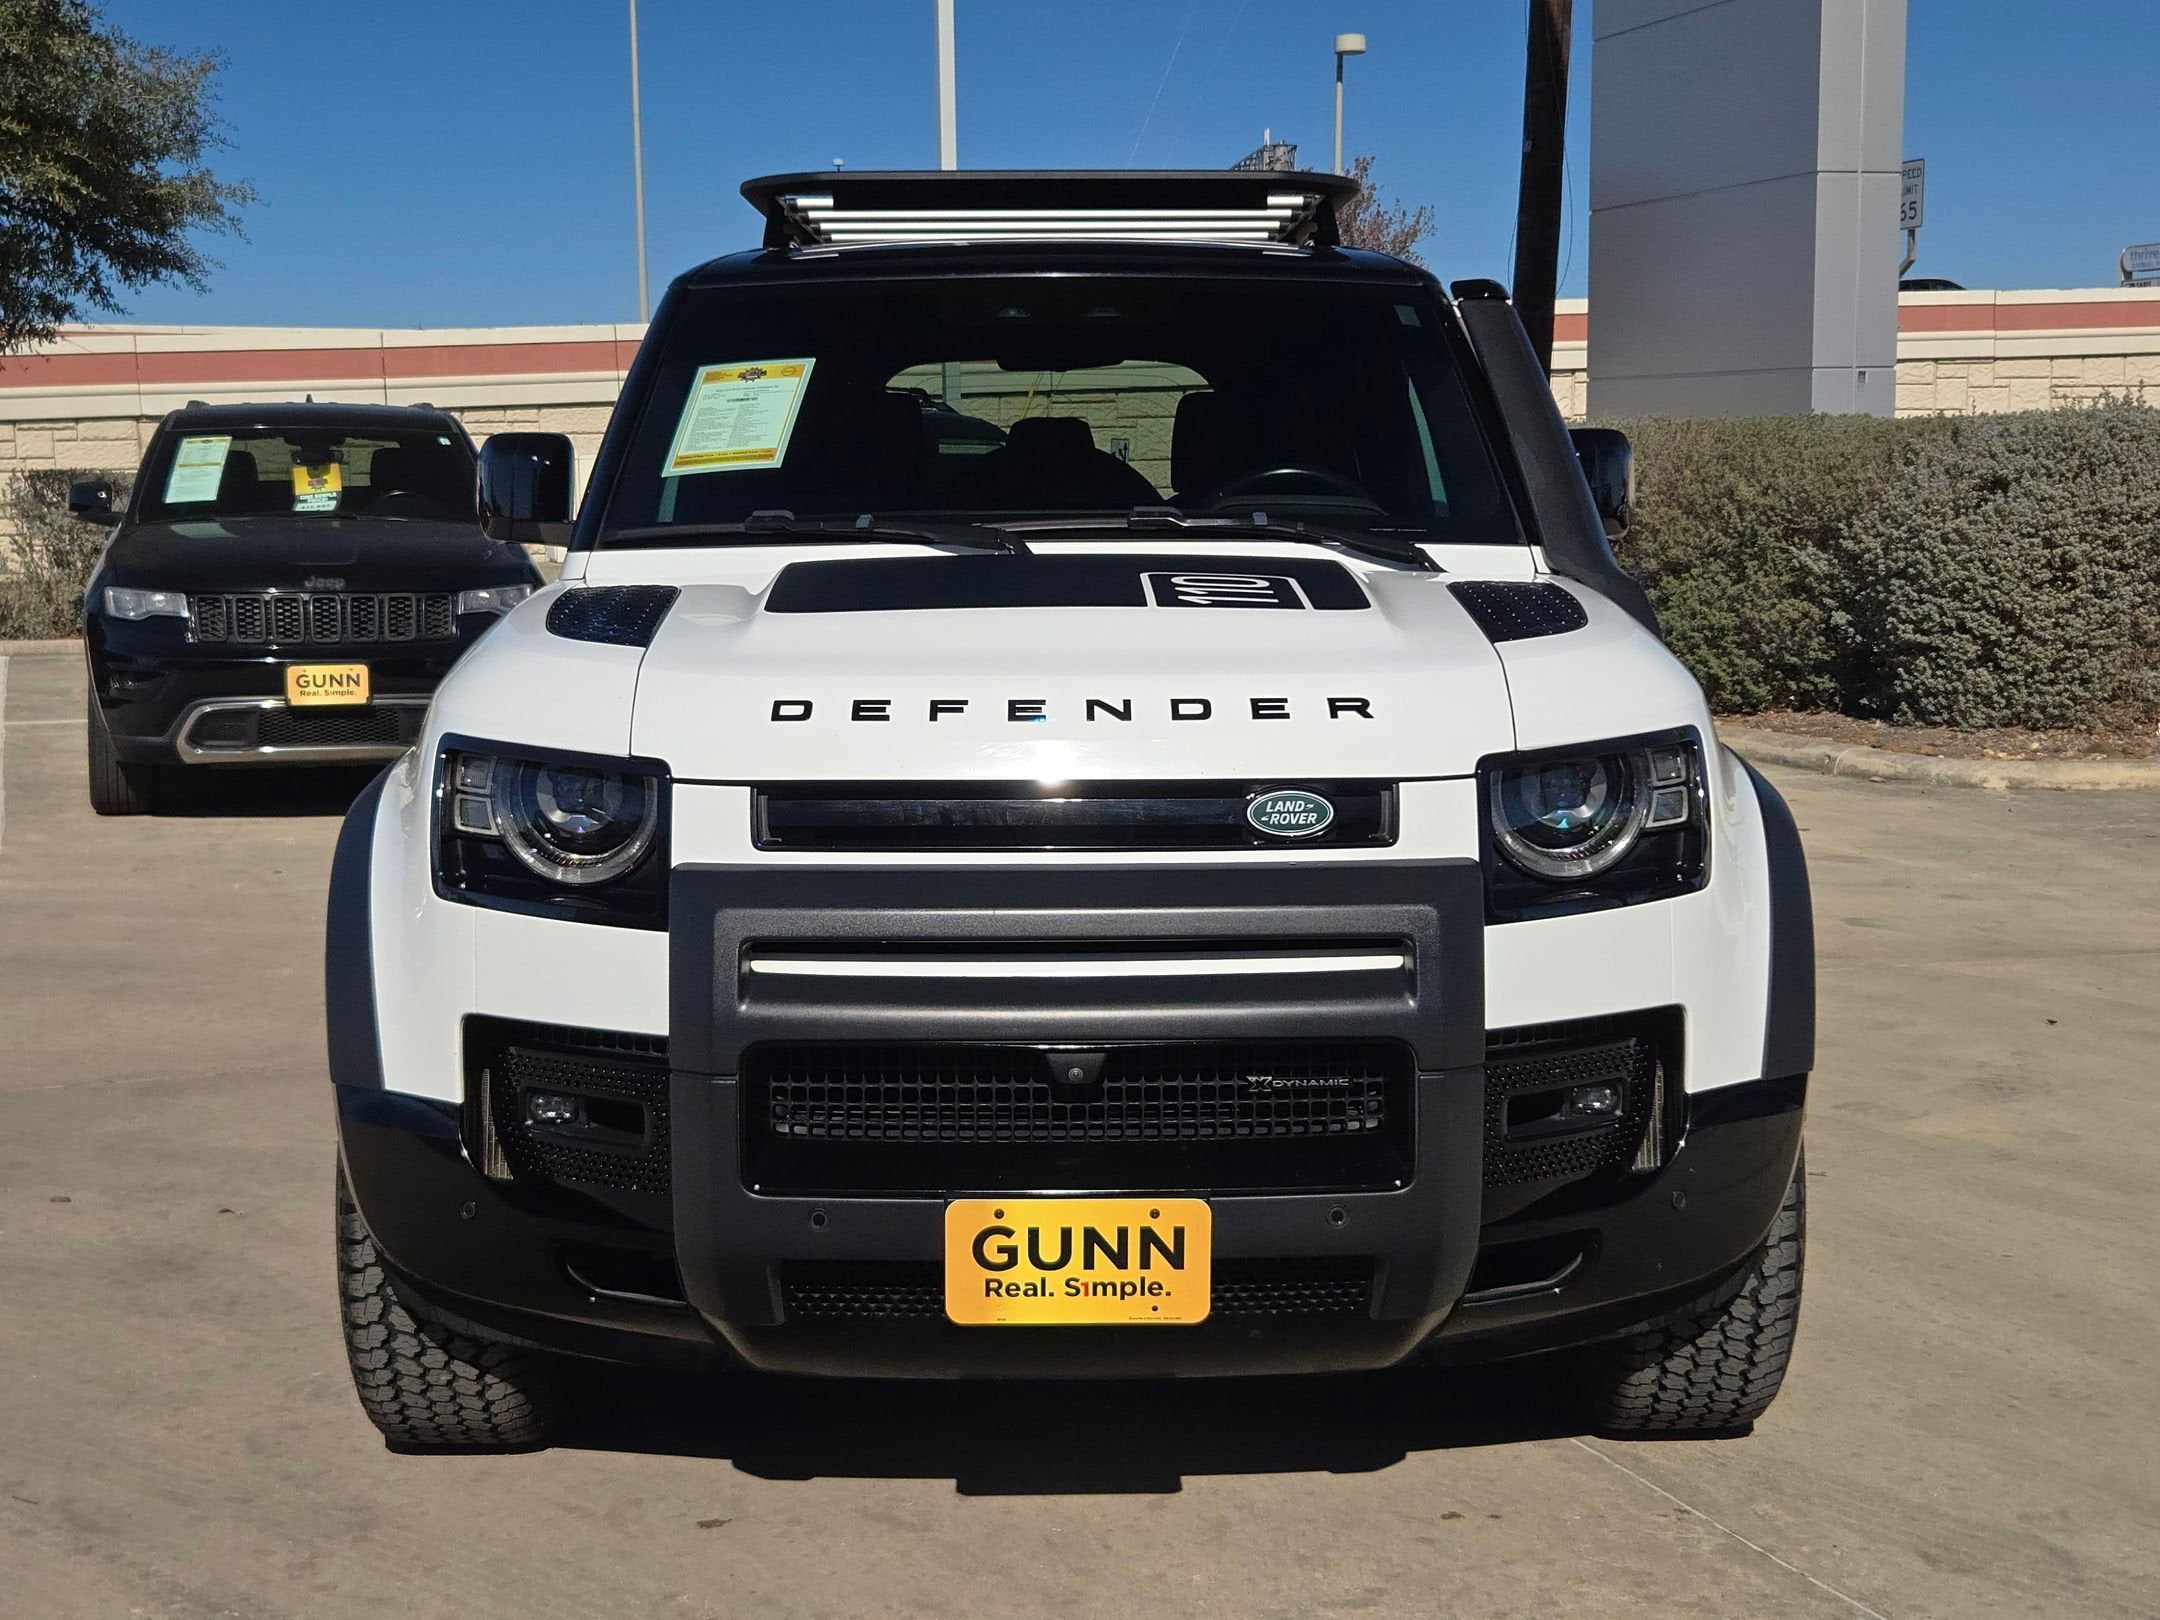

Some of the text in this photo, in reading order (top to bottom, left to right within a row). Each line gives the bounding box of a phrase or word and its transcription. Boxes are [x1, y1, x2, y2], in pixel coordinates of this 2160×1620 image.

[1901, 167, 1922, 180] PEED
[1901, 183, 1919, 196] IMIT
[295, 673, 361, 689] GUNN
[299, 689, 321, 698] Real.
[770, 697, 1375, 723] DEFENDER
[1265, 800, 1305, 813] LAND
[1269, 812, 1318, 825] ROVER
[971, 1225, 1185, 1272] GUNN
[984, 1276, 1055, 1298] Real.
